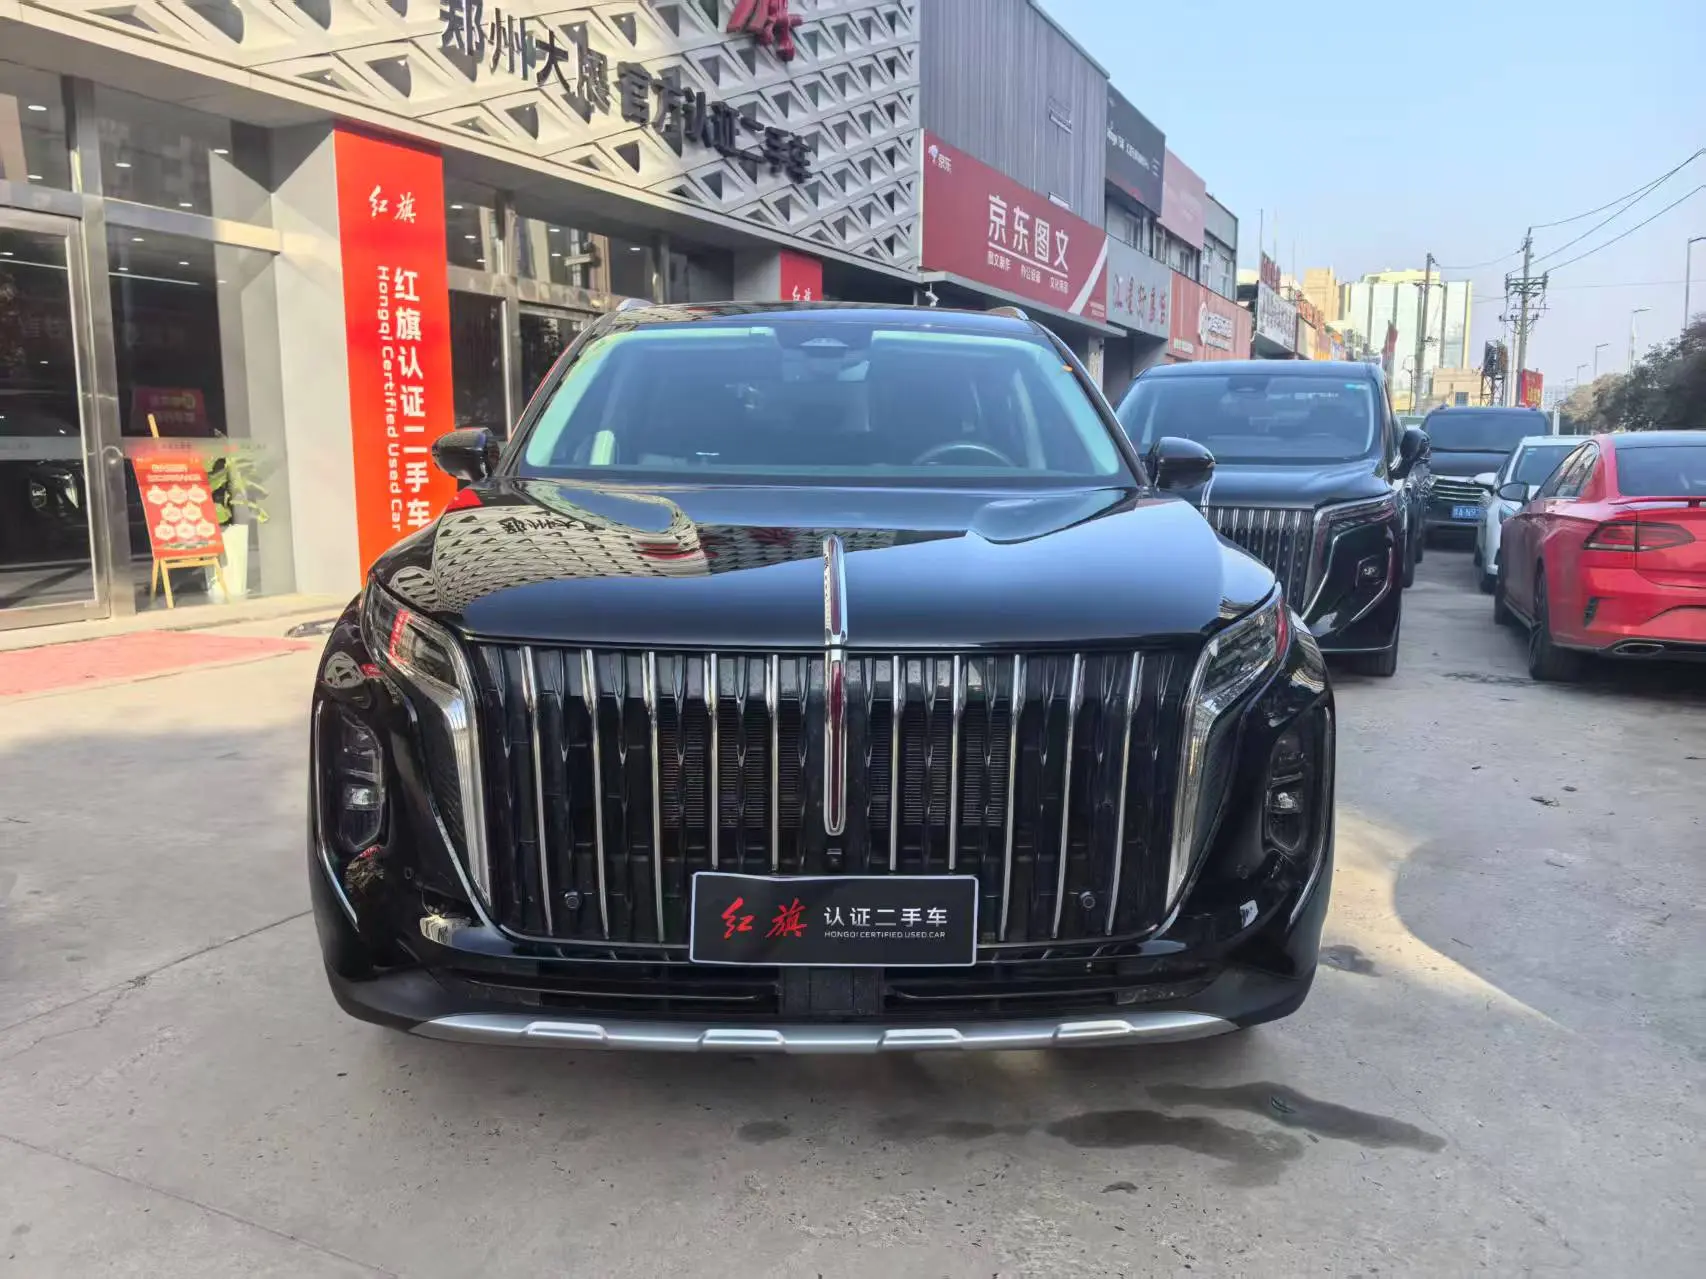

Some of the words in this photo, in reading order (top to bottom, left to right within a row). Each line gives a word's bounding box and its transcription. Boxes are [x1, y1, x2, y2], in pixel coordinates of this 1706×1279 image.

[369, 185, 416, 223] 红旗
[988, 194, 1069, 271] 京东图文
[382, 345, 398, 437] Certified
[394, 267, 431, 528] 红旗认证二手车
[387, 444, 402, 493] Used
[391, 499, 402, 532] Car
[721, 896, 807, 939] 红旗
[824, 906, 947, 927] 认证二手车
